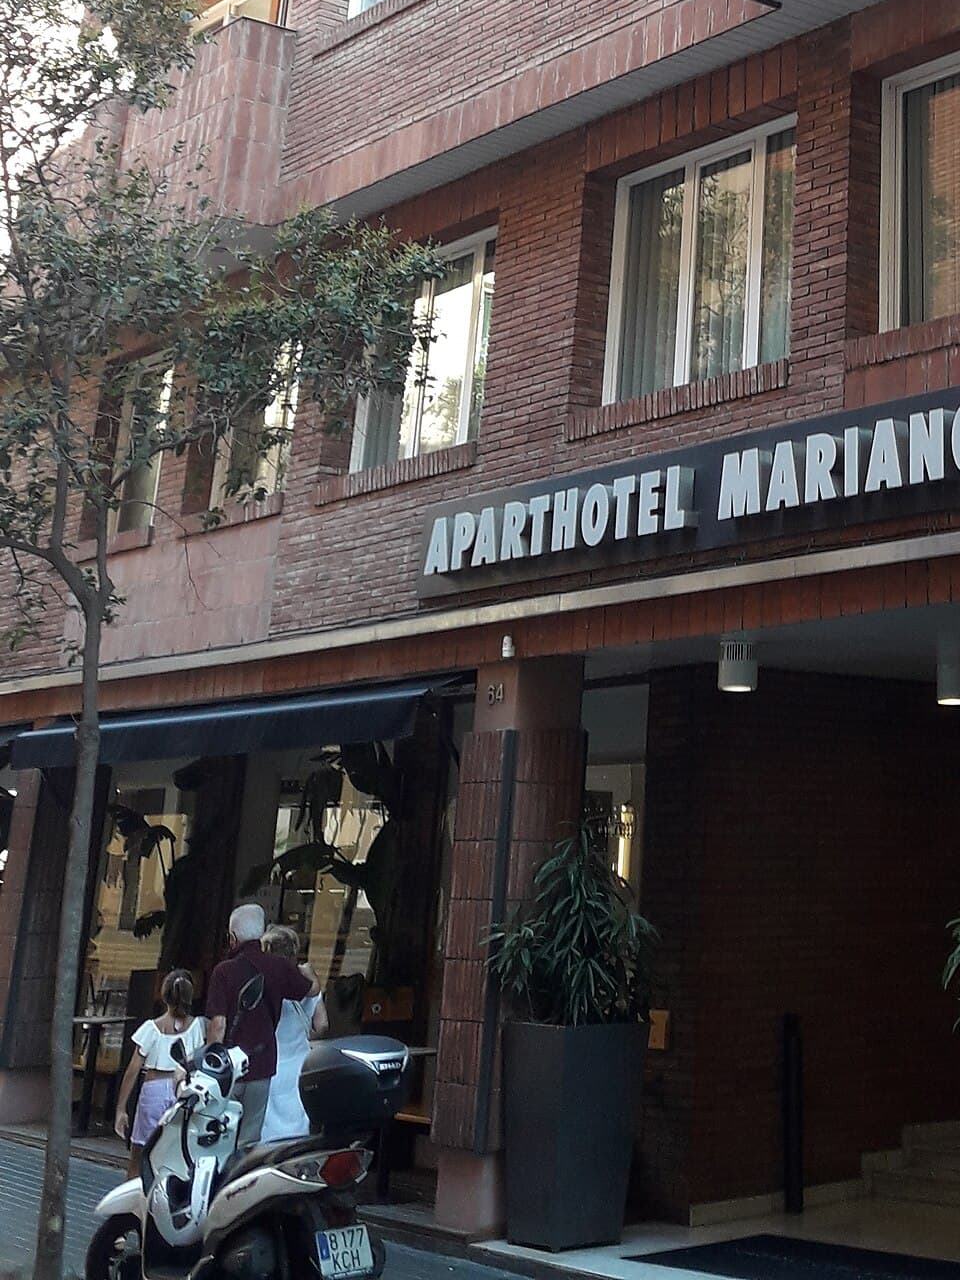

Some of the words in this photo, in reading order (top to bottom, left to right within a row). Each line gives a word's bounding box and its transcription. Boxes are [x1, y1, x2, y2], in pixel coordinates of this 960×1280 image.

[422, 463, 696, 577] APARTHOTEL
[488, 683, 504, 705] 64
[329, 1228, 364, 1251] 8177
[332, 1248, 361, 1272] KCH
